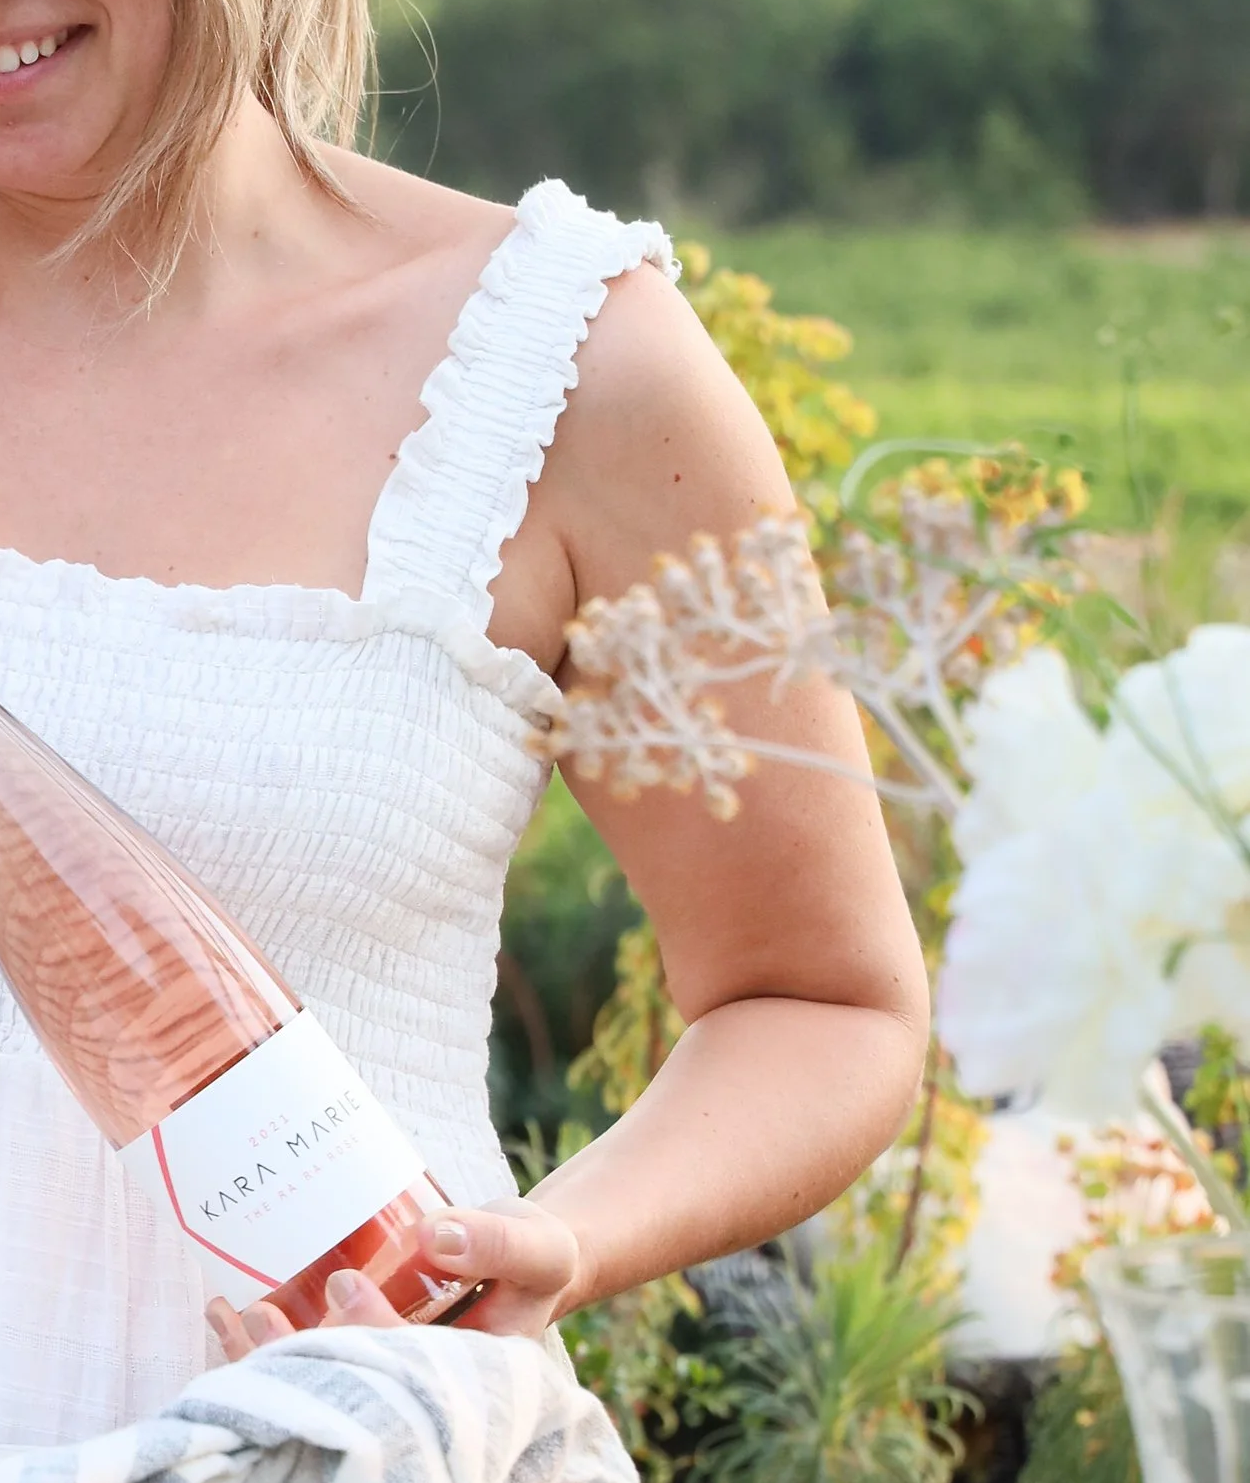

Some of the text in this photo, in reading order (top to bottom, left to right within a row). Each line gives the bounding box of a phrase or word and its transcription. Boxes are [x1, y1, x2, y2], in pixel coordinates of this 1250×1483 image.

[249, 1114, 289, 1148] 2021
[199, 1090, 360, 1221] KARA MARIE
[244, 1201, 271, 1223] THE
